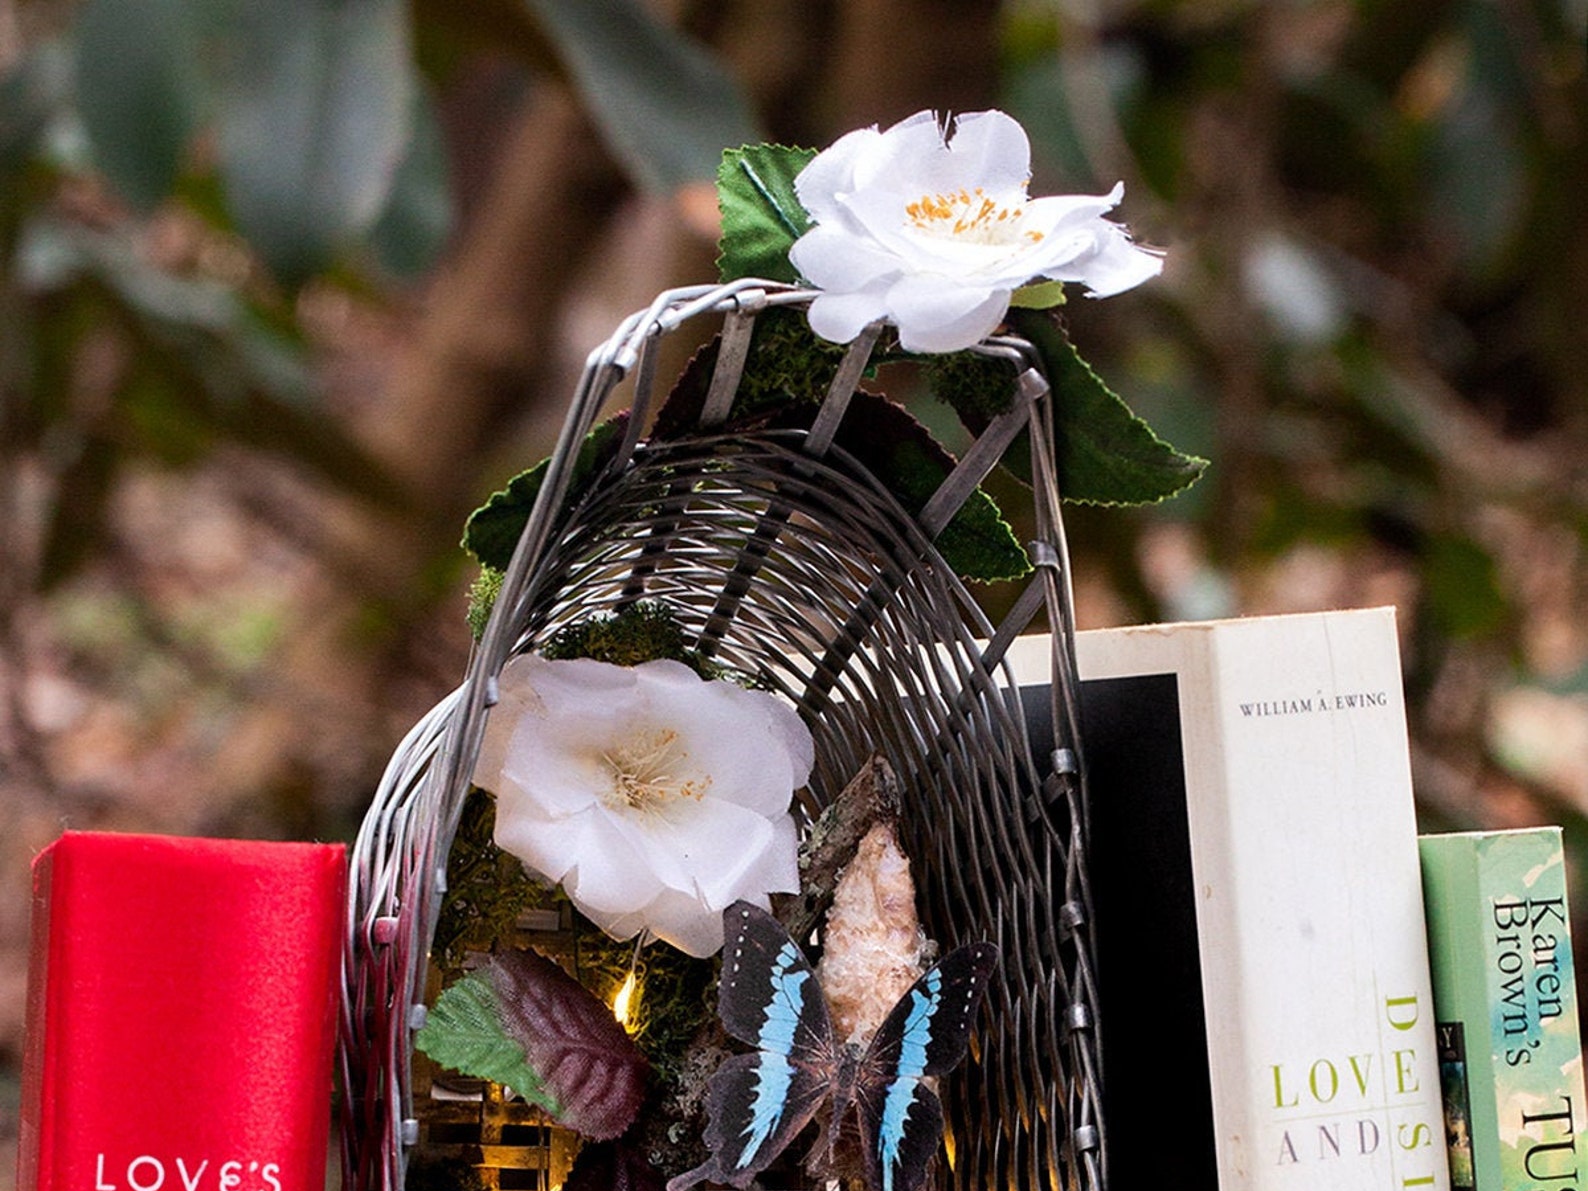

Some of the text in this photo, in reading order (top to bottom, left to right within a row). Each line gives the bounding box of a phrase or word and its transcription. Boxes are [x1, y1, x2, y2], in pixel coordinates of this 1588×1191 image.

[1239, 700, 1312, 717] WILLIAM
[1335, 692, 1387, 709] EWING
[1493, 900, 1541, 1067] Brown's
[1531, 896, 1565, 1019] Karen
[1276, 1118, 1380, 1166] AND
